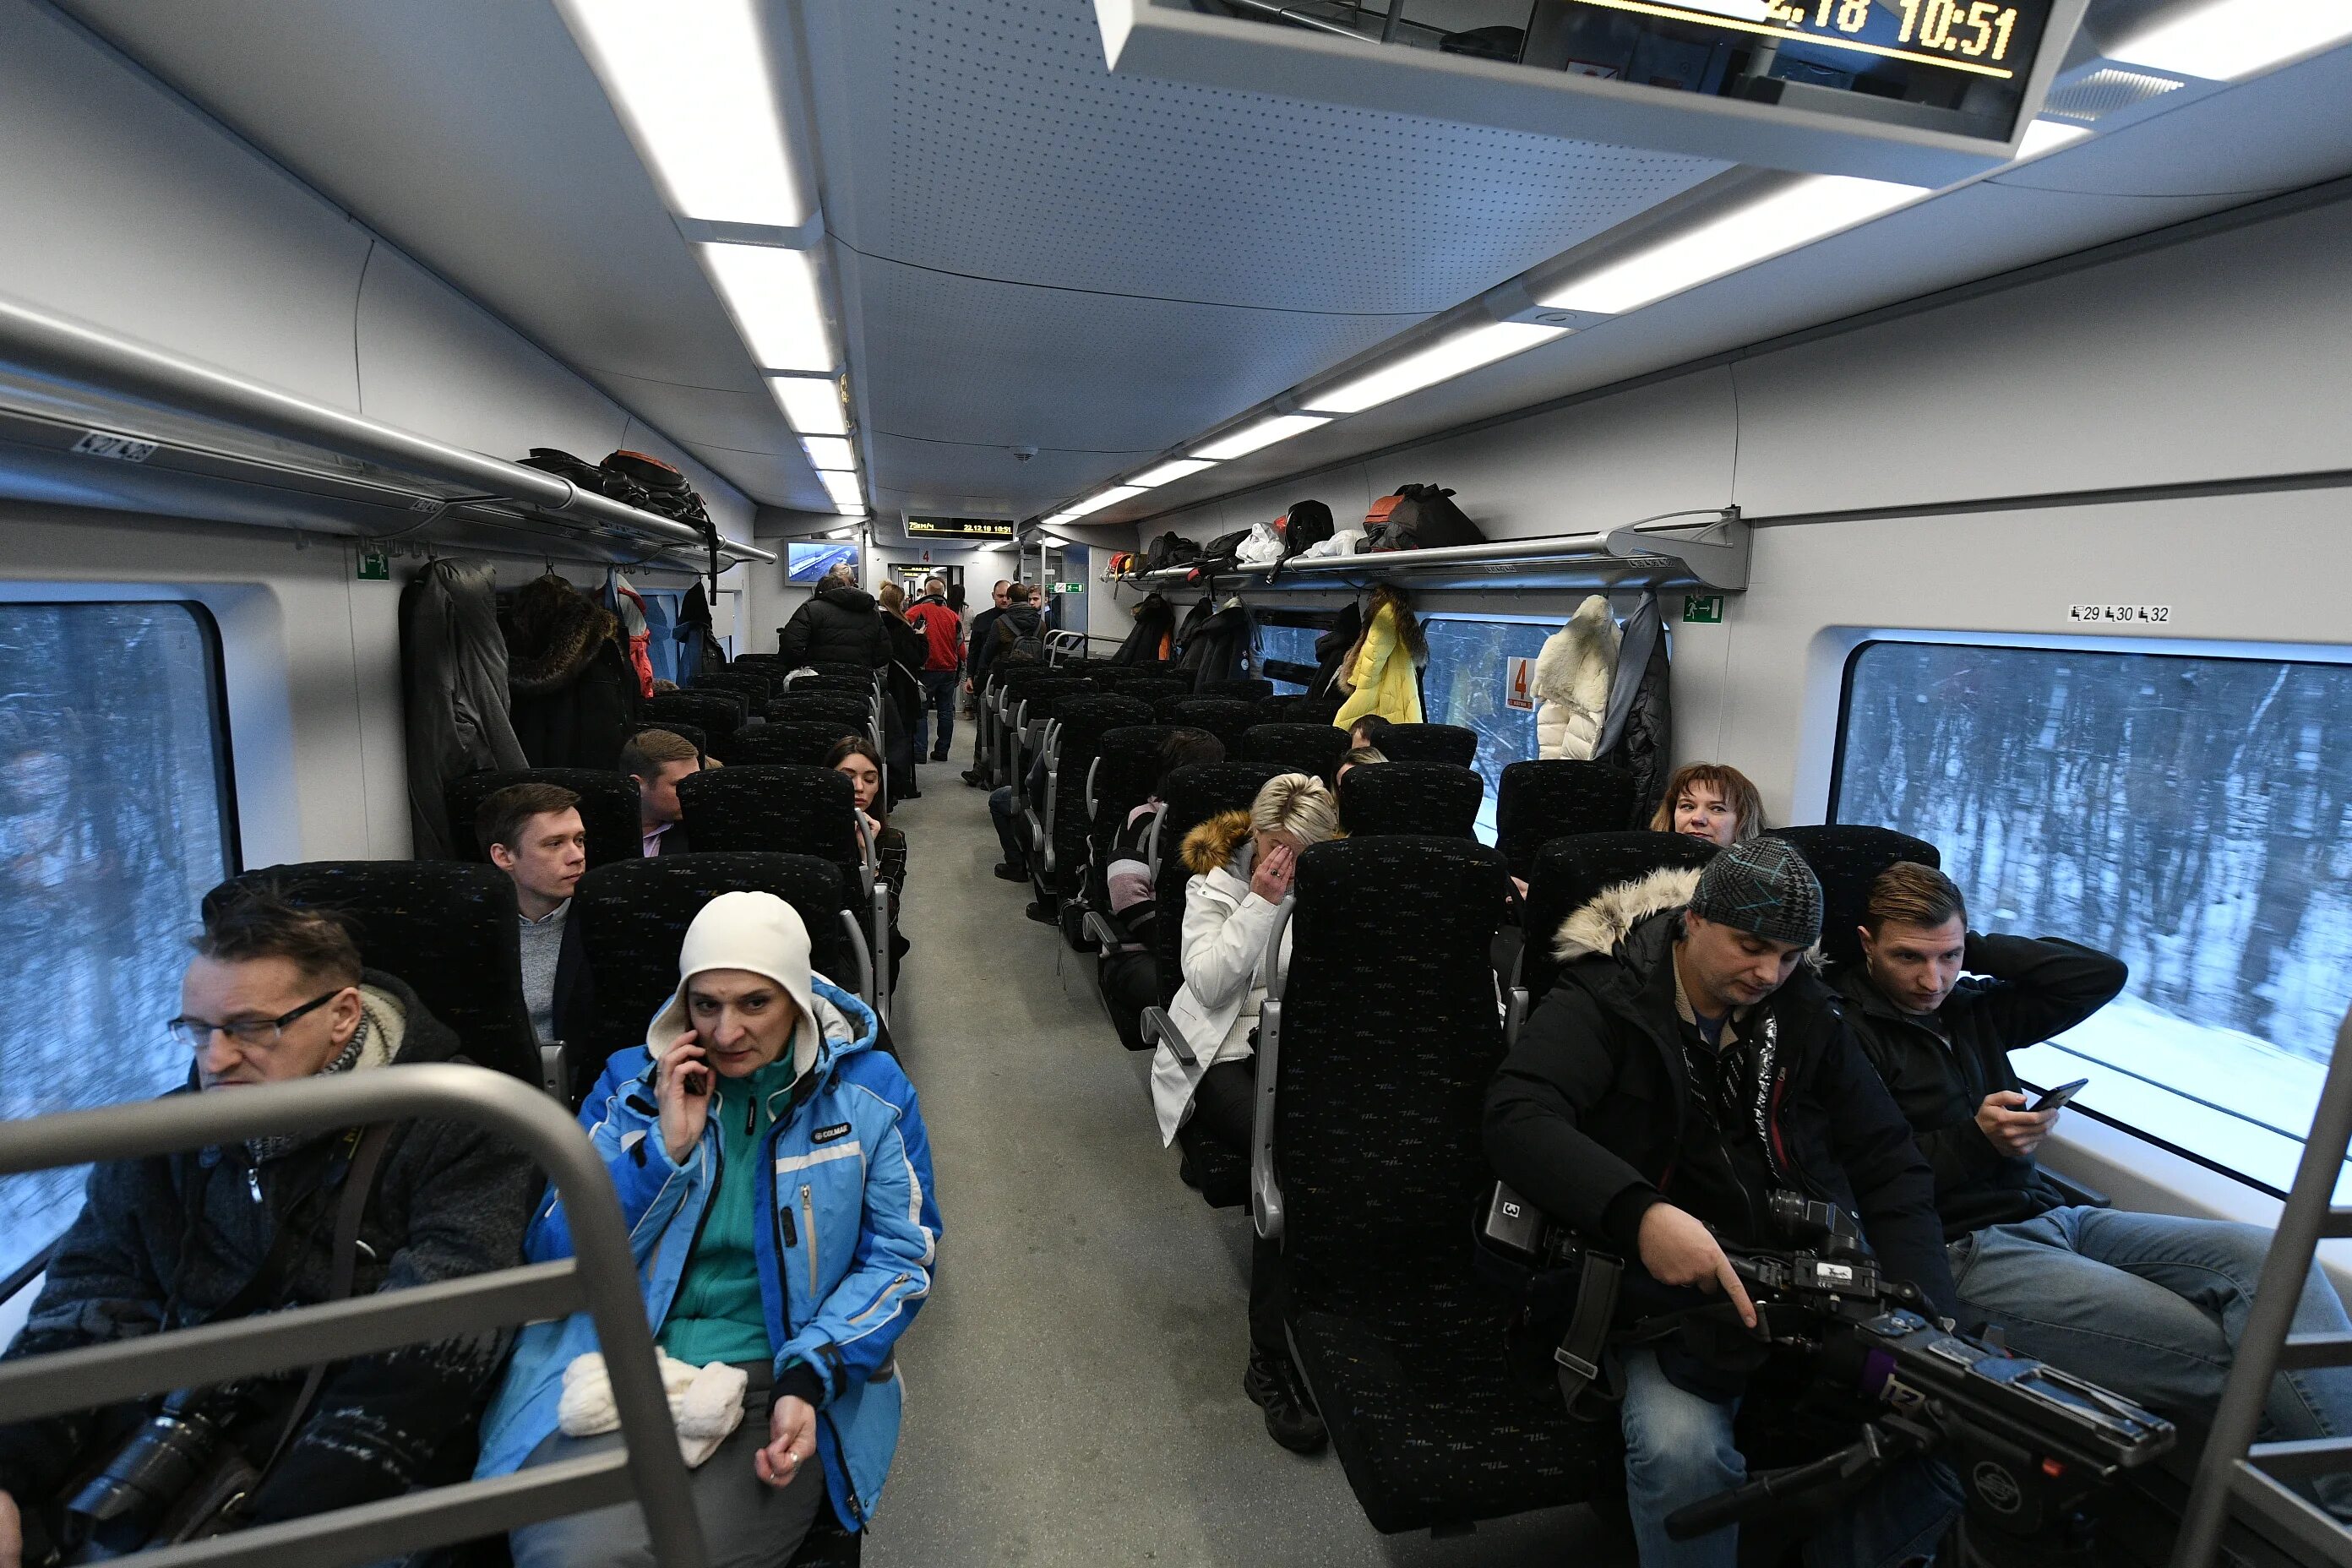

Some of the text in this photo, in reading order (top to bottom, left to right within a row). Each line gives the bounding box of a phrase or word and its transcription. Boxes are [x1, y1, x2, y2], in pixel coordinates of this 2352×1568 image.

[1897, 0, 2017, 60] 10:51
[923, 550, 929, 562] 4
[2083, 607, 2169, 622] 29 30 32
[1515, 659, 1527, 700] 4
[1505, 1203, 1518, 1215] 3
